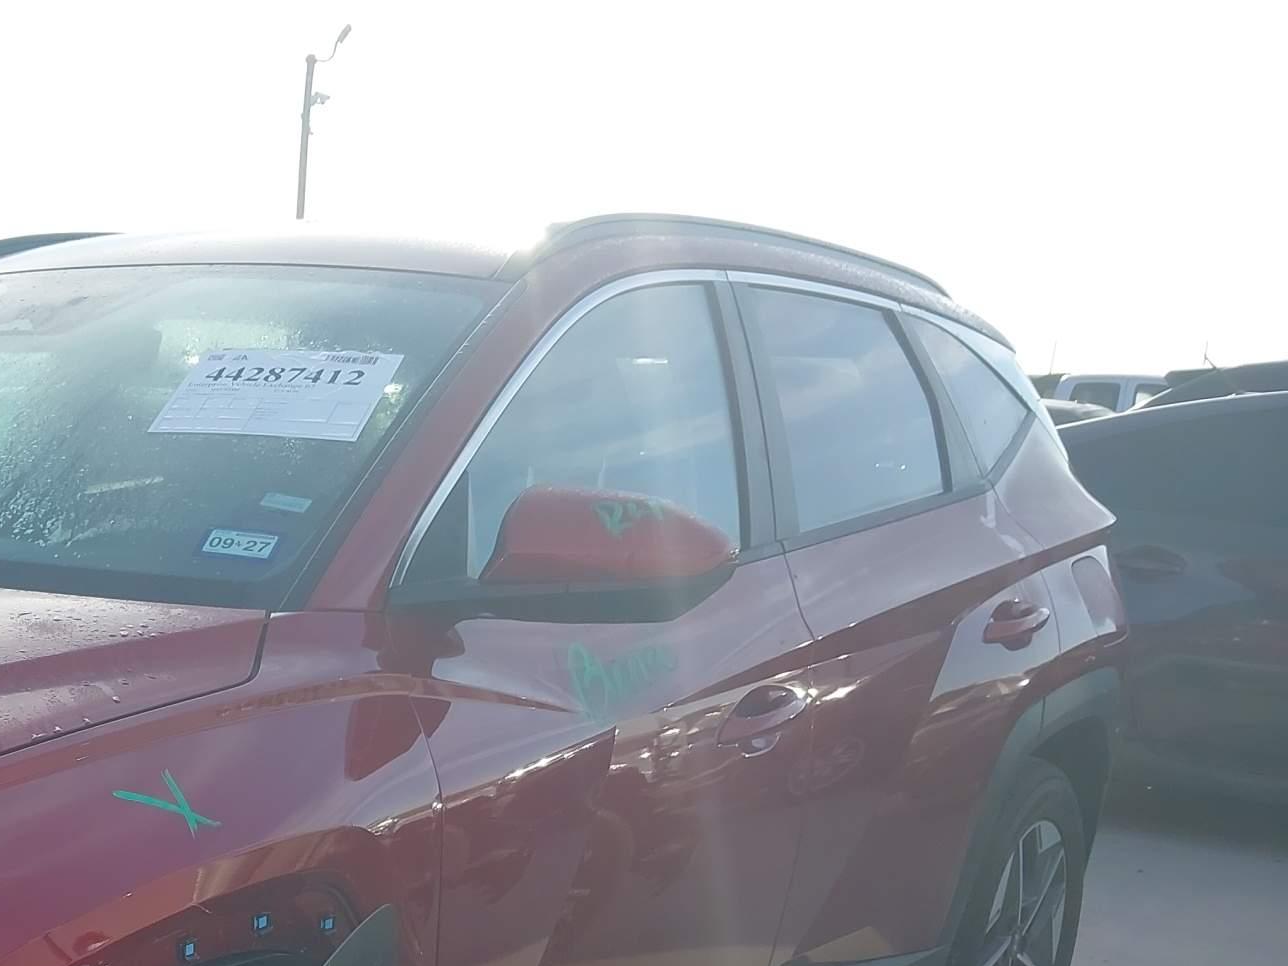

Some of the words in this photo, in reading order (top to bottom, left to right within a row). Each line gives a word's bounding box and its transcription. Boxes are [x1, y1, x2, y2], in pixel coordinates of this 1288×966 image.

[206, 366, 366, 386] 44287412
[209, 536, 235, 549] 09
[243, 540, 272, 553] 27
